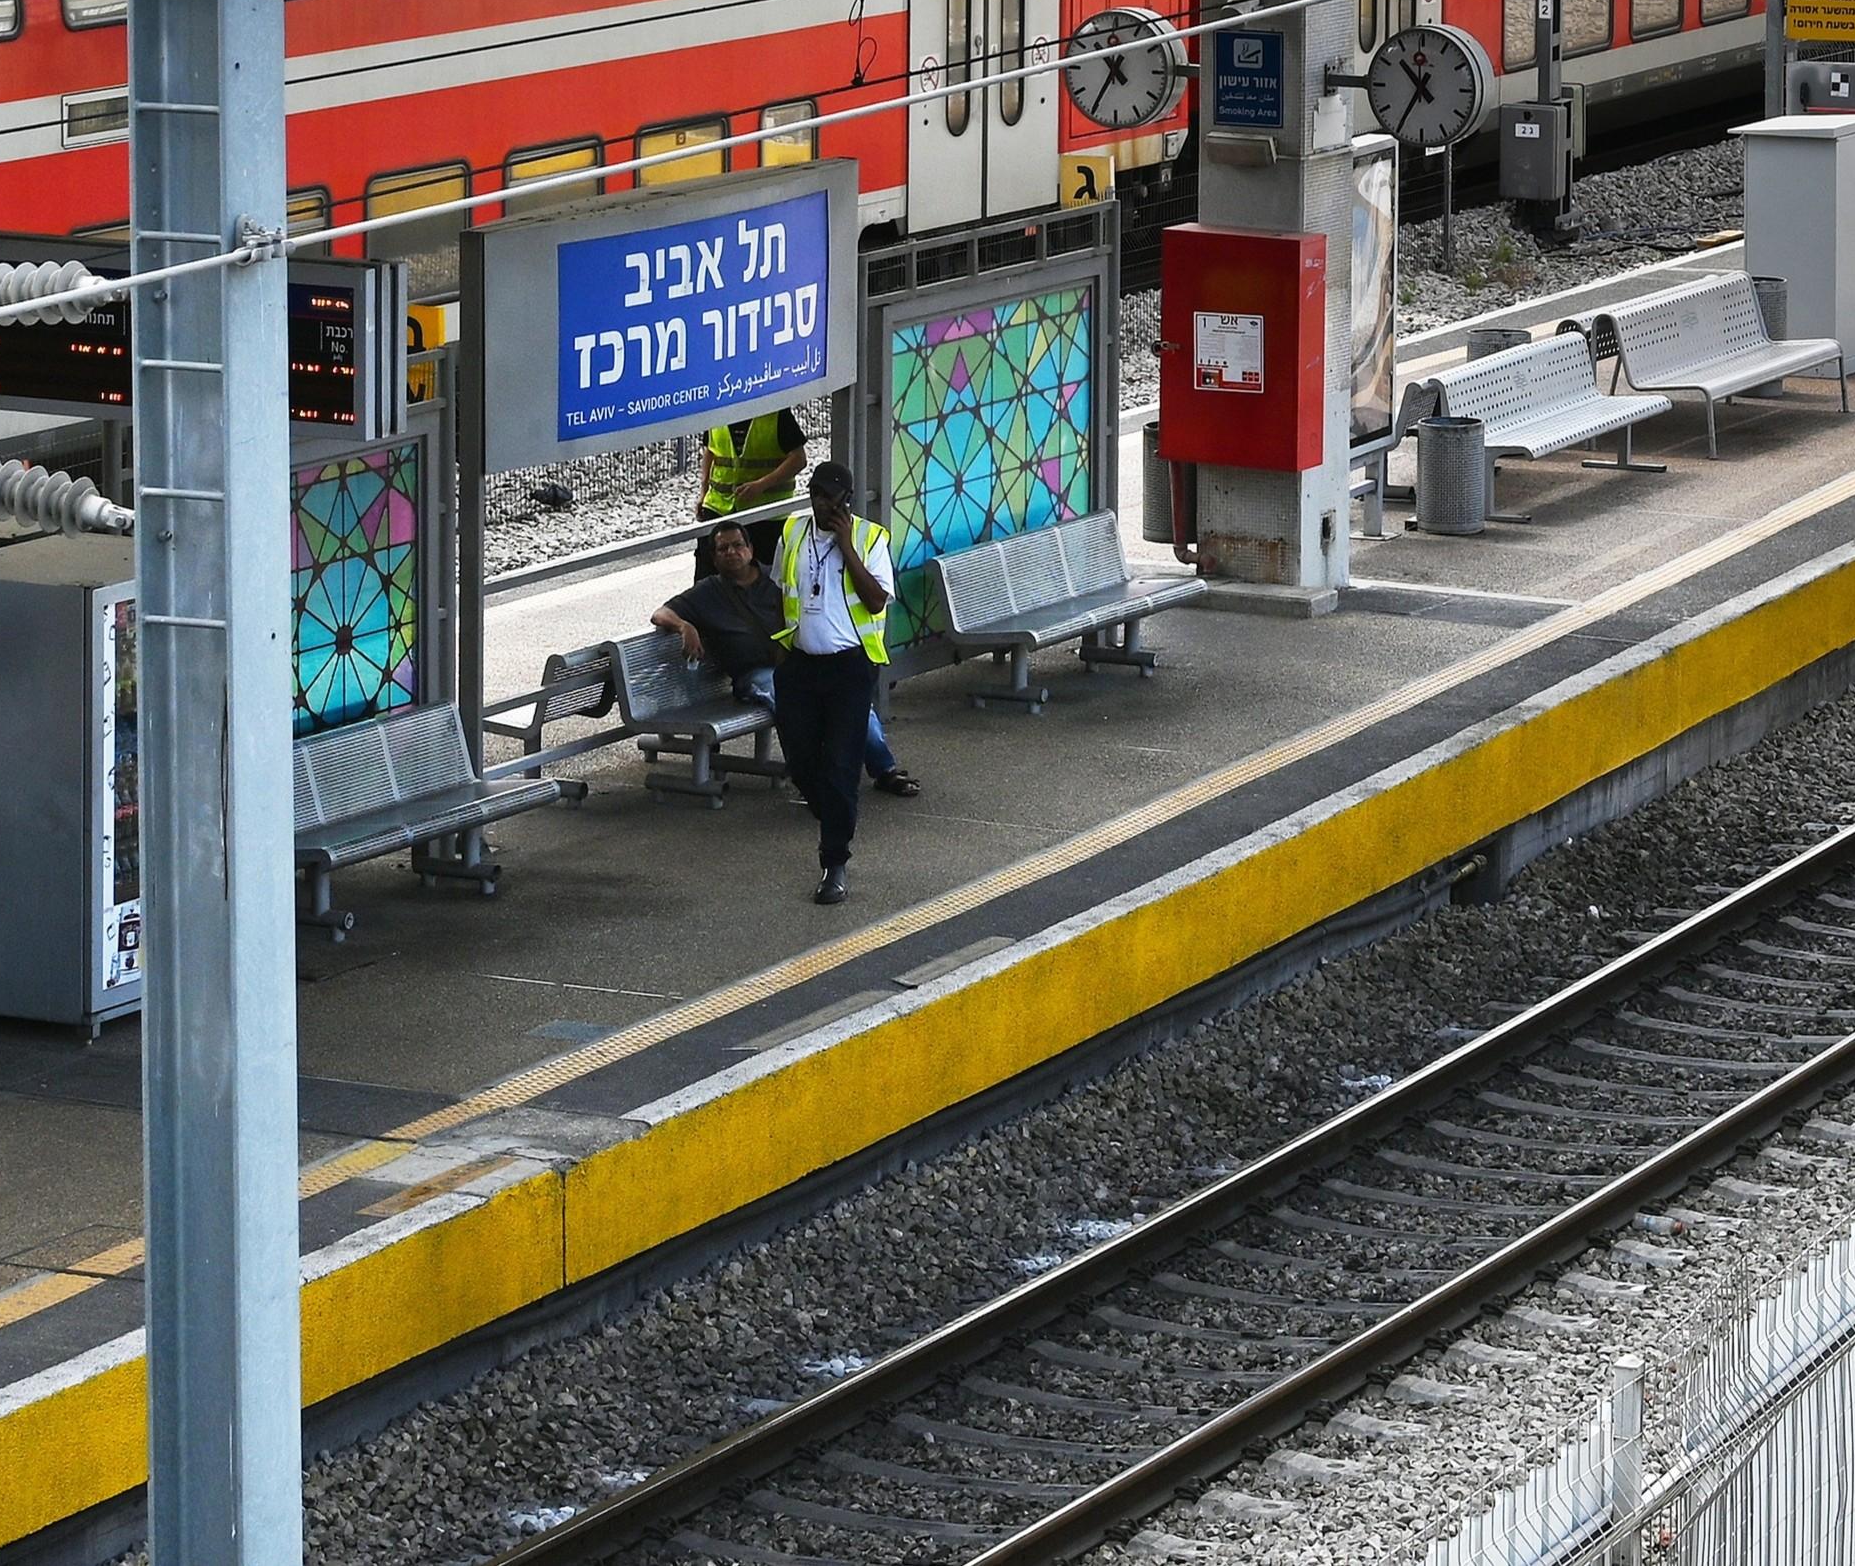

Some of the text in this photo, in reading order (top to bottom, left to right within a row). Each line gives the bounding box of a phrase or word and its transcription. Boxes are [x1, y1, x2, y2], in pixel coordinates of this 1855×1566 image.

[1541, 4, 1549, 15] 2
[1219, 75, 1277, 89] אזור עישון
[1219, 106, 1277, 118] Smoking Area
[1073, 166, 1097, 200] ג
[624, 219, 786, 308] תל אביב
[1220, 316, 1238, 325] אש
[326, 325, 353, 338] רכבת
[574, 283, 818, 389] סבידור מרכז
[331, 341, 348, 353] No.
[566, 411, 587, 427] TEL
[589, 405, 615, 421] AVIV
[627, 391, 671, 415] SAVIDOR
[673, 384, 710, 404] CENTER
